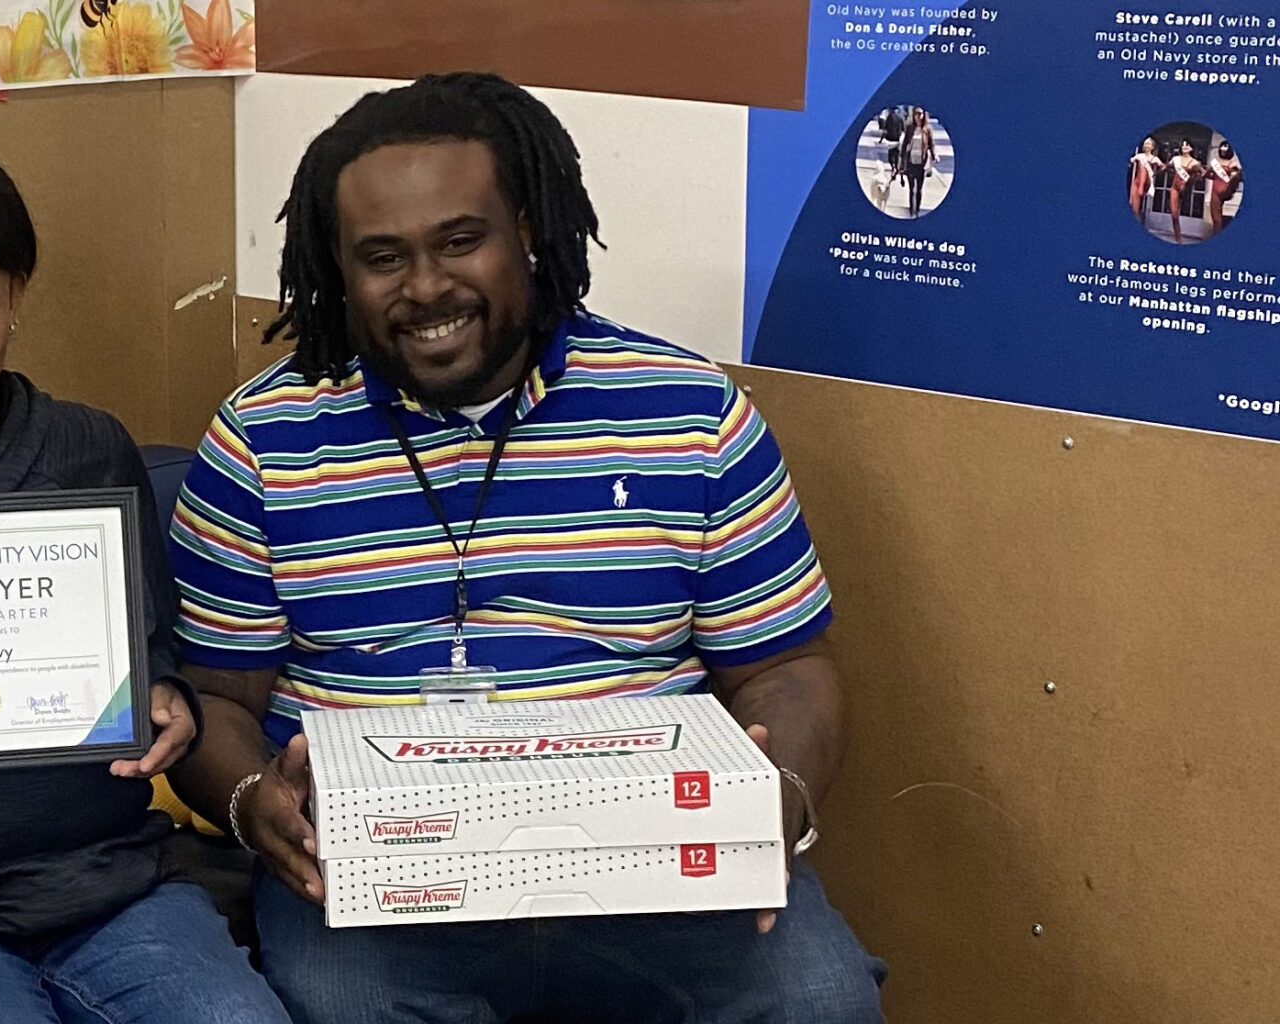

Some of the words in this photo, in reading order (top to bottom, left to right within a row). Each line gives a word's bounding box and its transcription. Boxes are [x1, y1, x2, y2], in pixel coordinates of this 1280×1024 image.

[827, 5, 849, 16] Old
[854, 5, 885, 18] Navy
[891, 7, 915, 17] was
[921, 6, 976, 19] founded
[982, 8, 998, 22] by
[1116, 12, 1159, 25] Steve
[1165, 13, 1212, 26] Carell
[1219, 15, 1260, 27] (with
[1267, 18, 1276, 28] a
[845, 22, 870, 33] Don
[875, 23, 884, 33] &
[889, 23, 924, 35] Doris
[831, 38, 851, 49] the
[857, 39, 875, 50] OG
[881, 41, 935, 53] creators
[941, 42, 955, 53] of
[960, 43, 990, 56] Gap.
[1095, 31, 1179, 45] mustache!)
[1186, 34, 1223, 45] once
[1097, 51, 1114, 60] an
[1120, 49, 1147, 61] Old
[1153, 51, 1190, 65] Navy
[1197, 53, 1237, 65] store
[1244, 53, 1258, 65] in
[1123, 69, 1168, 80] movie
[1174, 69, 1260, 85] Sleepover.
[841, 232, 880, 246] Olivia
[939, 242, 965, 256] dog
[873, 253, 897, 264] was
[902, 256, 924, 266] our
[929, 258, 977, 273] mascot
[1088, 256, 1114, 269] The
[1120, 259, 1197, 278] Rockettes
[1203, 269, 1231, 281] and
[1238, 271, 1276, 285] their
[840, 264, 859, 275] for
[863, 269, 870, 277] a
[875, 270, 910, 282] quick
[915, 274, 965, 288] minute.
[1067, 273, 1169, 293] world-famous
[1175, 283, 1207, 297] legs
[1079, 292, 1093, 302] at
[1099, 295, 1123, 305] our
[1129, 295, 1211, 315] Manhattan
[1216, 305, 1280, 324] flagship
[1142, 316, 1211, 334] opening.
[28, 542, 98, 562] VISION
[395, 739, 531, 758] Krispy
[533, 732, 667, 753] Kreme
[447, 751, 624, 764] DOUGHNUTS
[682, 781, 702, 797] 12
[372, 820, 414, 837] Krispy
[413, 819, 454, 835] Kreme
[688, 849, 707, 865] 12
[381, 889, 423, 906] Krispy
[422, 887, 463, 904] Kreme
